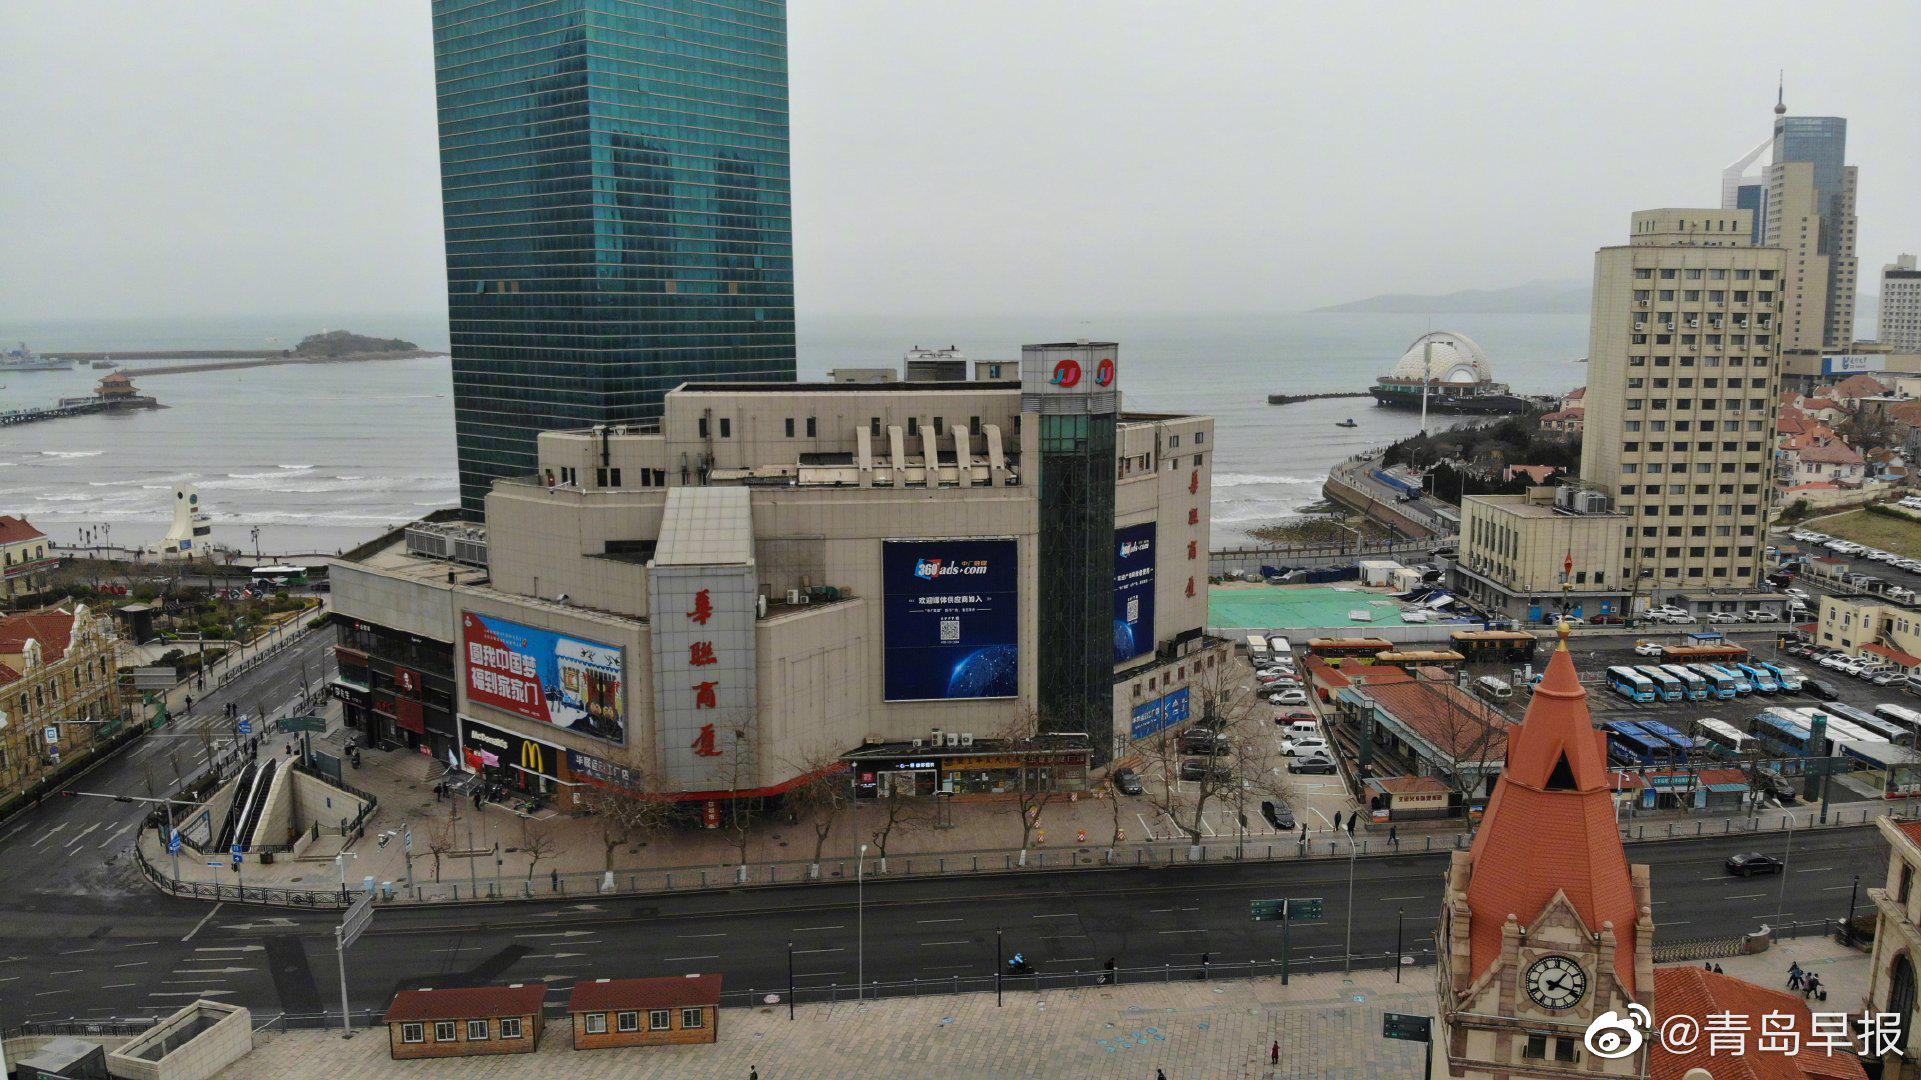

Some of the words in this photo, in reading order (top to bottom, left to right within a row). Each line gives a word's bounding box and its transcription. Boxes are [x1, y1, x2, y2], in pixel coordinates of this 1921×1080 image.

[471, 666, 539, 706] 福到家家门
